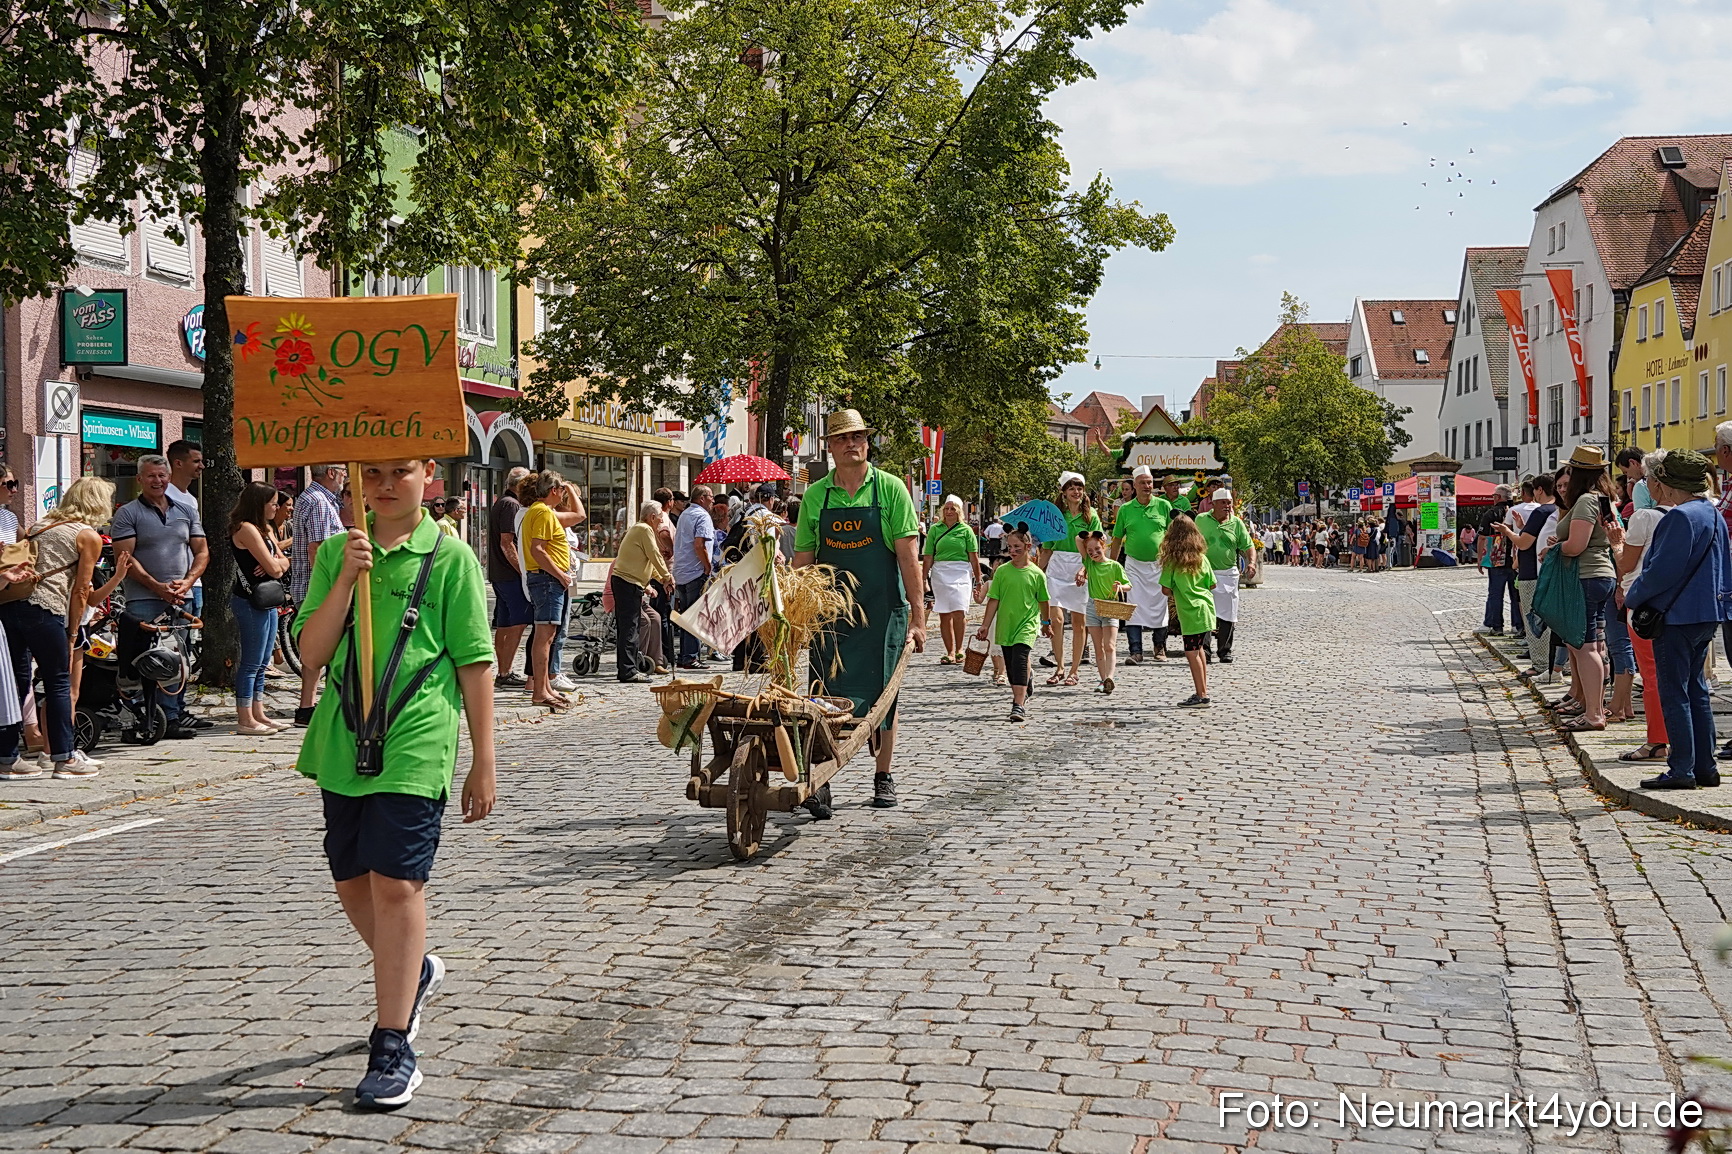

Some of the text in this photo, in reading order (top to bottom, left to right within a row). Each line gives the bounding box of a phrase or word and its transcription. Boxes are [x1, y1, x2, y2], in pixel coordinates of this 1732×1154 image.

[72, 303, 96, 317] vom
[81, 307, 115, 328] FASS
[329, 323, 451, 377] OGV
[1646, 358, 1665, 378] HOTEL
[580, 397, 607, 426] LEDER
[54, 421, 71, 431] ZONE
[83, 419, 156, 444] Spirituosen Whisky
[237, 411, 461, 453] Woffenbach e.V.
[1136, 454, 1207, 468] OGV Woffenbach
[832, 520, 862, 532] OGV
[825, 536, 873, 550] Woffenbach
[407, 582, 430, 597] OV
